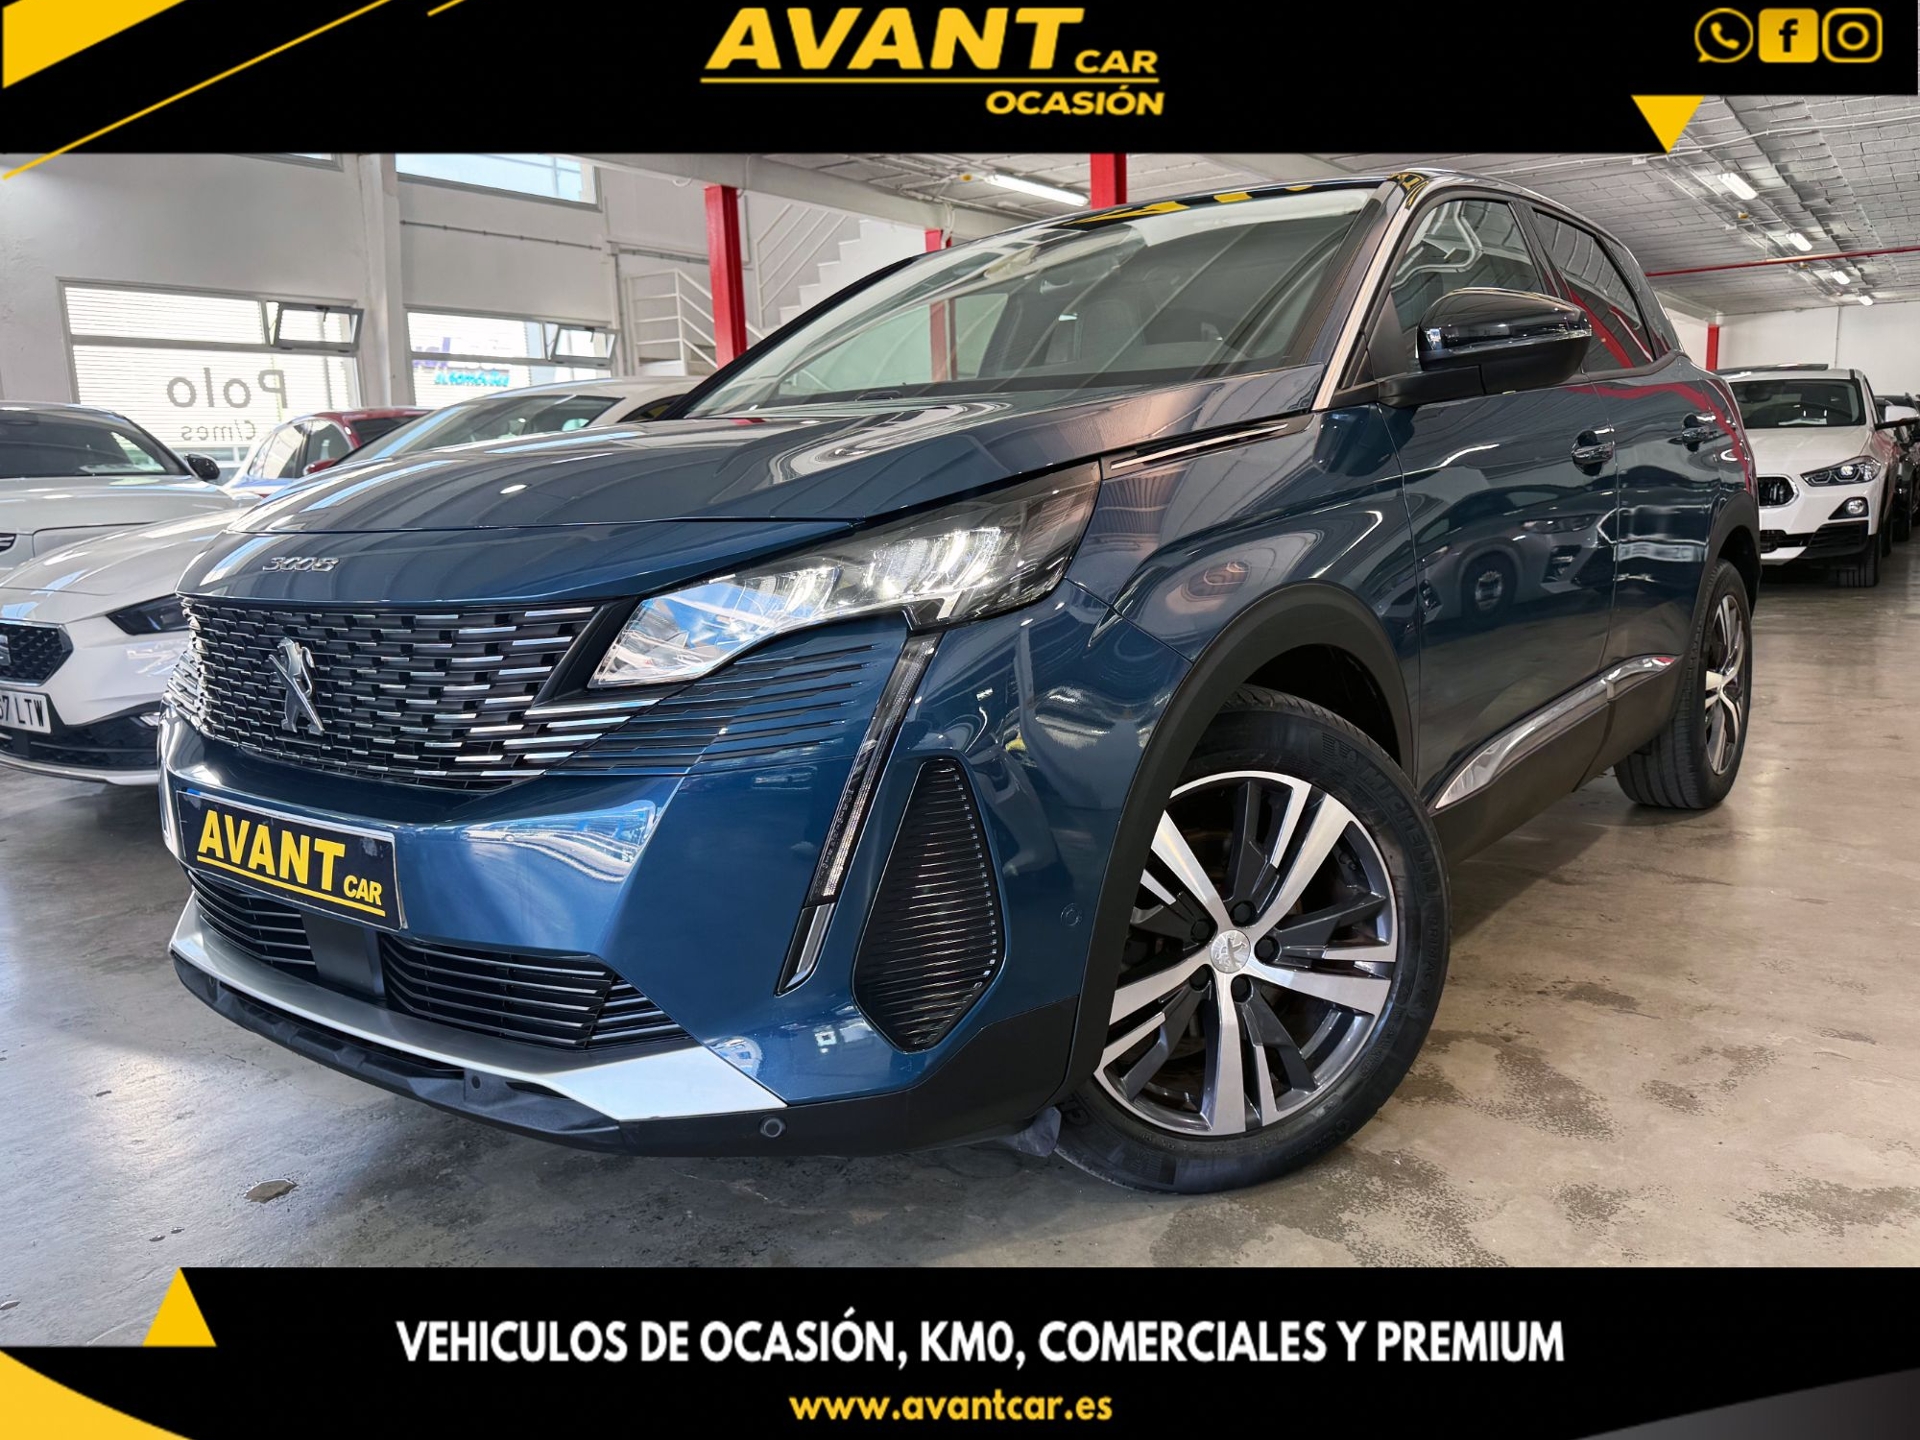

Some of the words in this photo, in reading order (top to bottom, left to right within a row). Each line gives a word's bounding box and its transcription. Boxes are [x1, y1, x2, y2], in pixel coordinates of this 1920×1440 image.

[262, 557, 339, 572] 3008
[198, 809, 346, 891] AVANT
[343, 874, 383, 906] CAR
